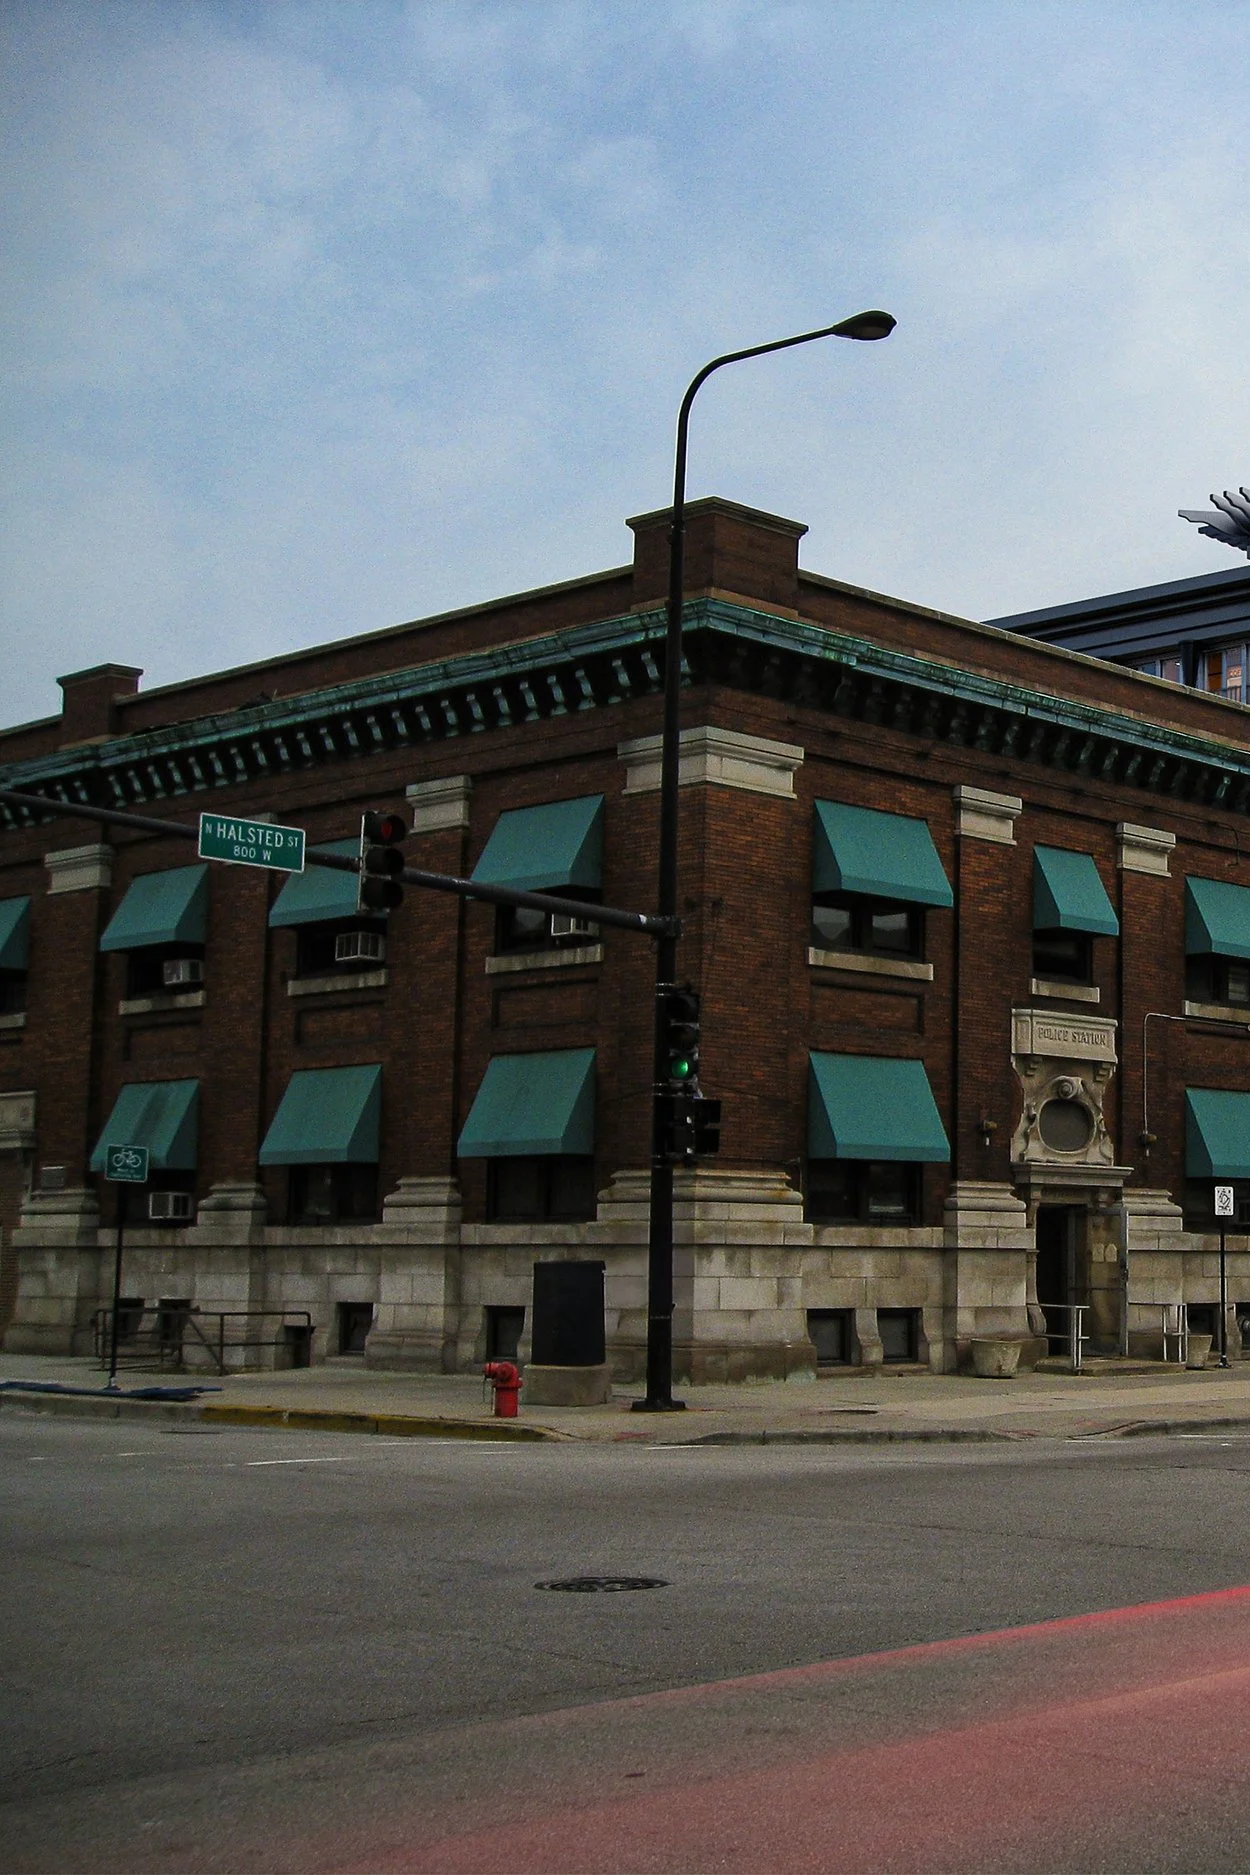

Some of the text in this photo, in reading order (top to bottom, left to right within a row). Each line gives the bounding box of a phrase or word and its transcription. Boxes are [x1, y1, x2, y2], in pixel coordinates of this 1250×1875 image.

[205, 821, 298, 848] N HALSTED ST
[233, 845, 272, 861] 800 W
[1038, 1027, 1106, 1046] POLICE STATION
